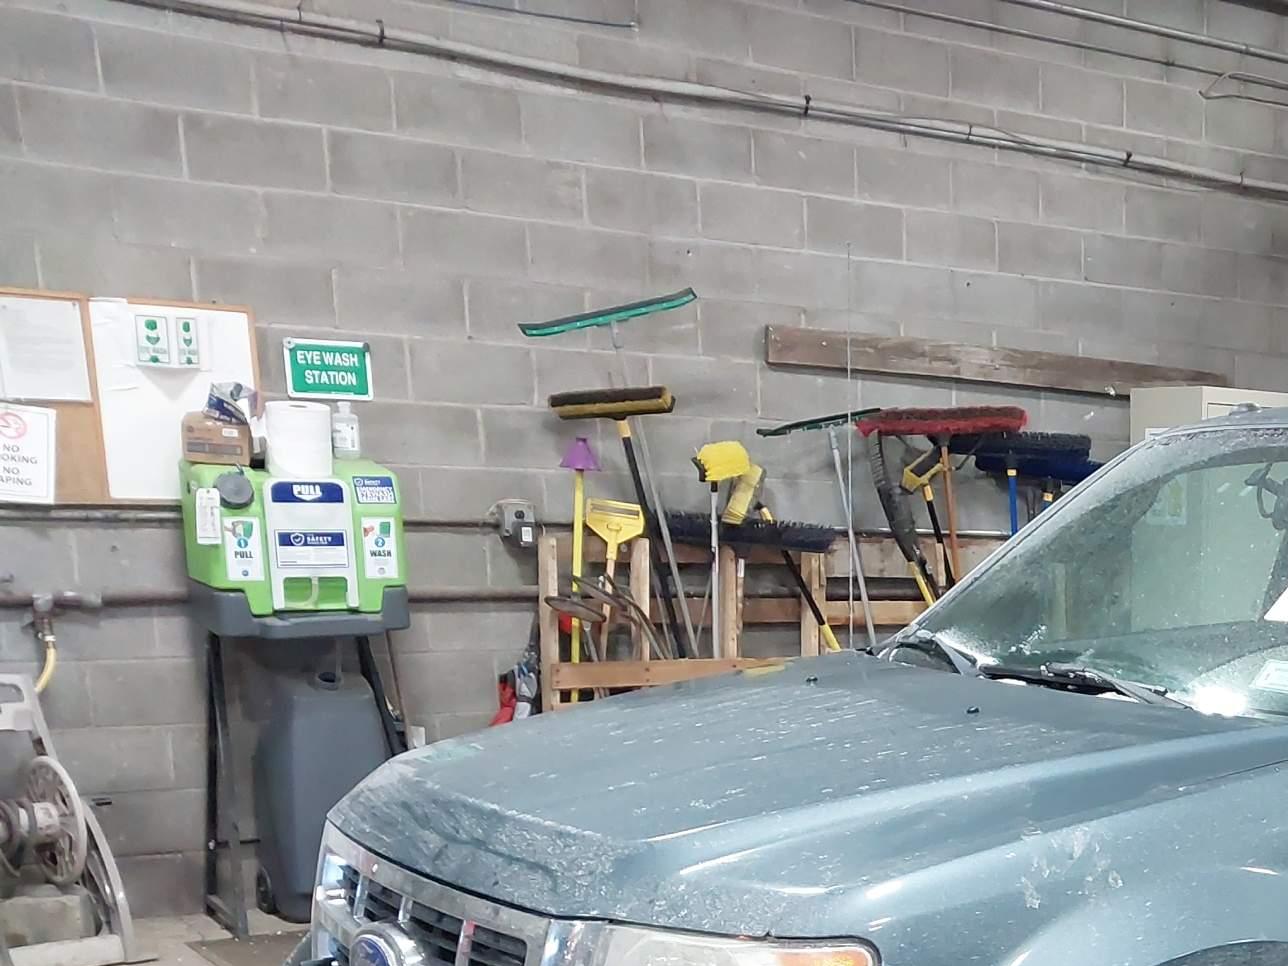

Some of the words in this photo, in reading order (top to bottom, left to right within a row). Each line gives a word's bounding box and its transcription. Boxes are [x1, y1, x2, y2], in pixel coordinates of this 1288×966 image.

[296, 350, 321, 365] EYE
[322, 351, 359, 367] WASH
[304, 369, 357, 386] STATION
[2, 444, 20, 453] NO
[2, 466, 20, 475] NO
[292, 484, 322, 496] PULL
[233, 550, 254, 559] PULL
[369, 549, 392, 557] WASH
